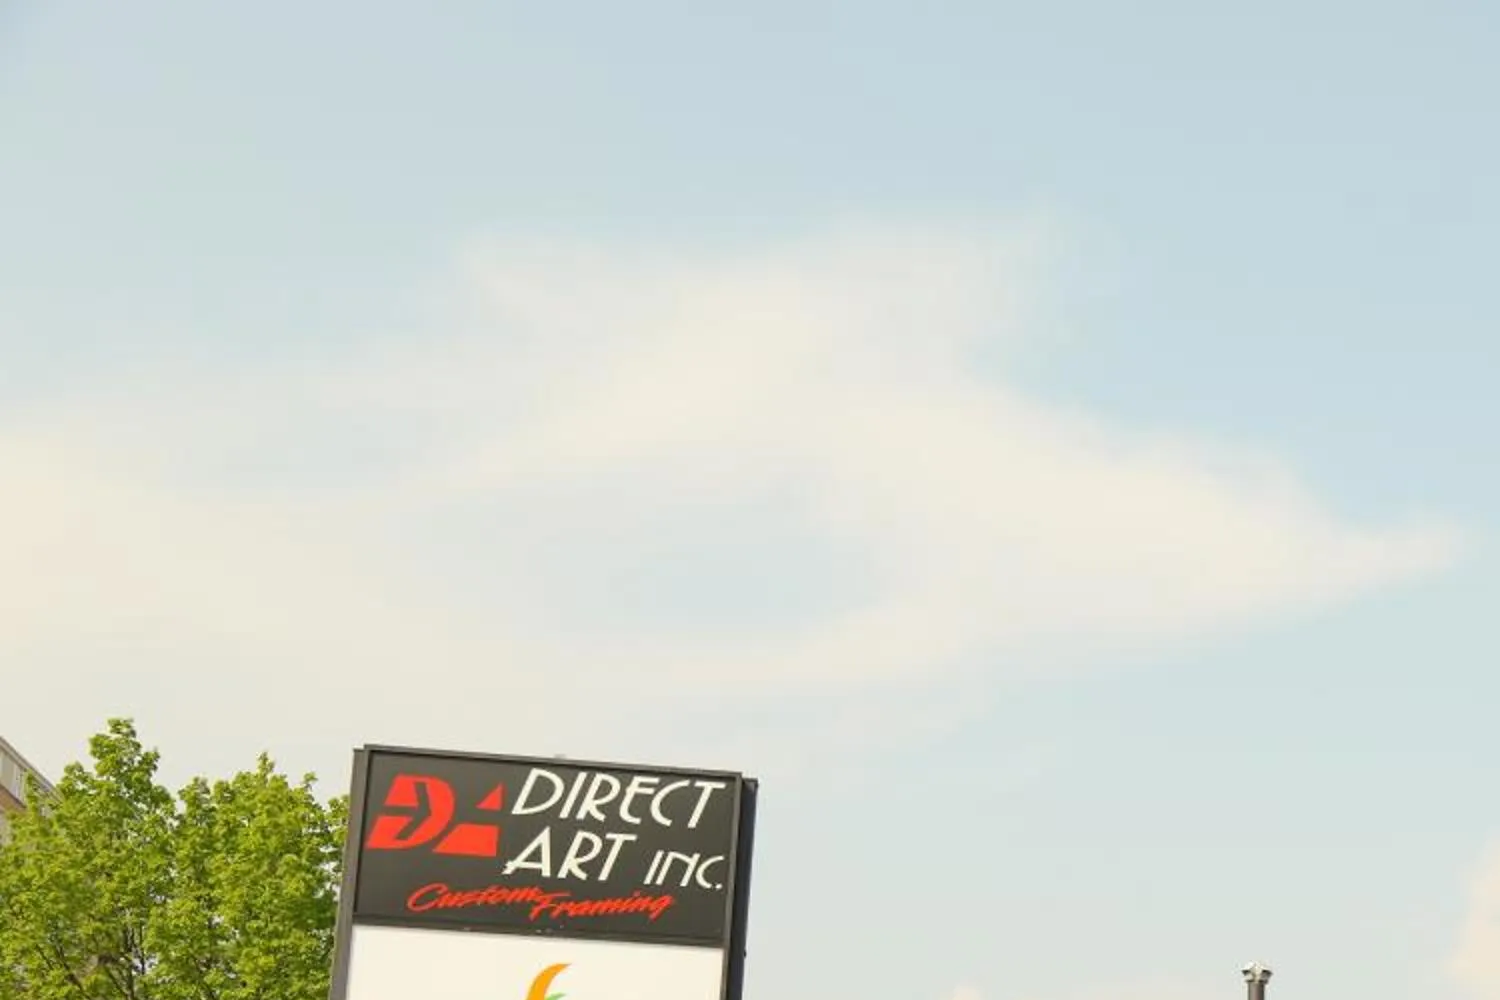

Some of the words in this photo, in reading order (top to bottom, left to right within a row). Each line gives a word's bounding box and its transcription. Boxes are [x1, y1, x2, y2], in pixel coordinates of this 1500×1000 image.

[511, 767, 726, 829] DIRECT
[501, 825, 637, 881] ART
[643, 850, 725, 889] INC.
[406, 882, 540, 912] Custom
[528, 890, 674, 922] Framing
